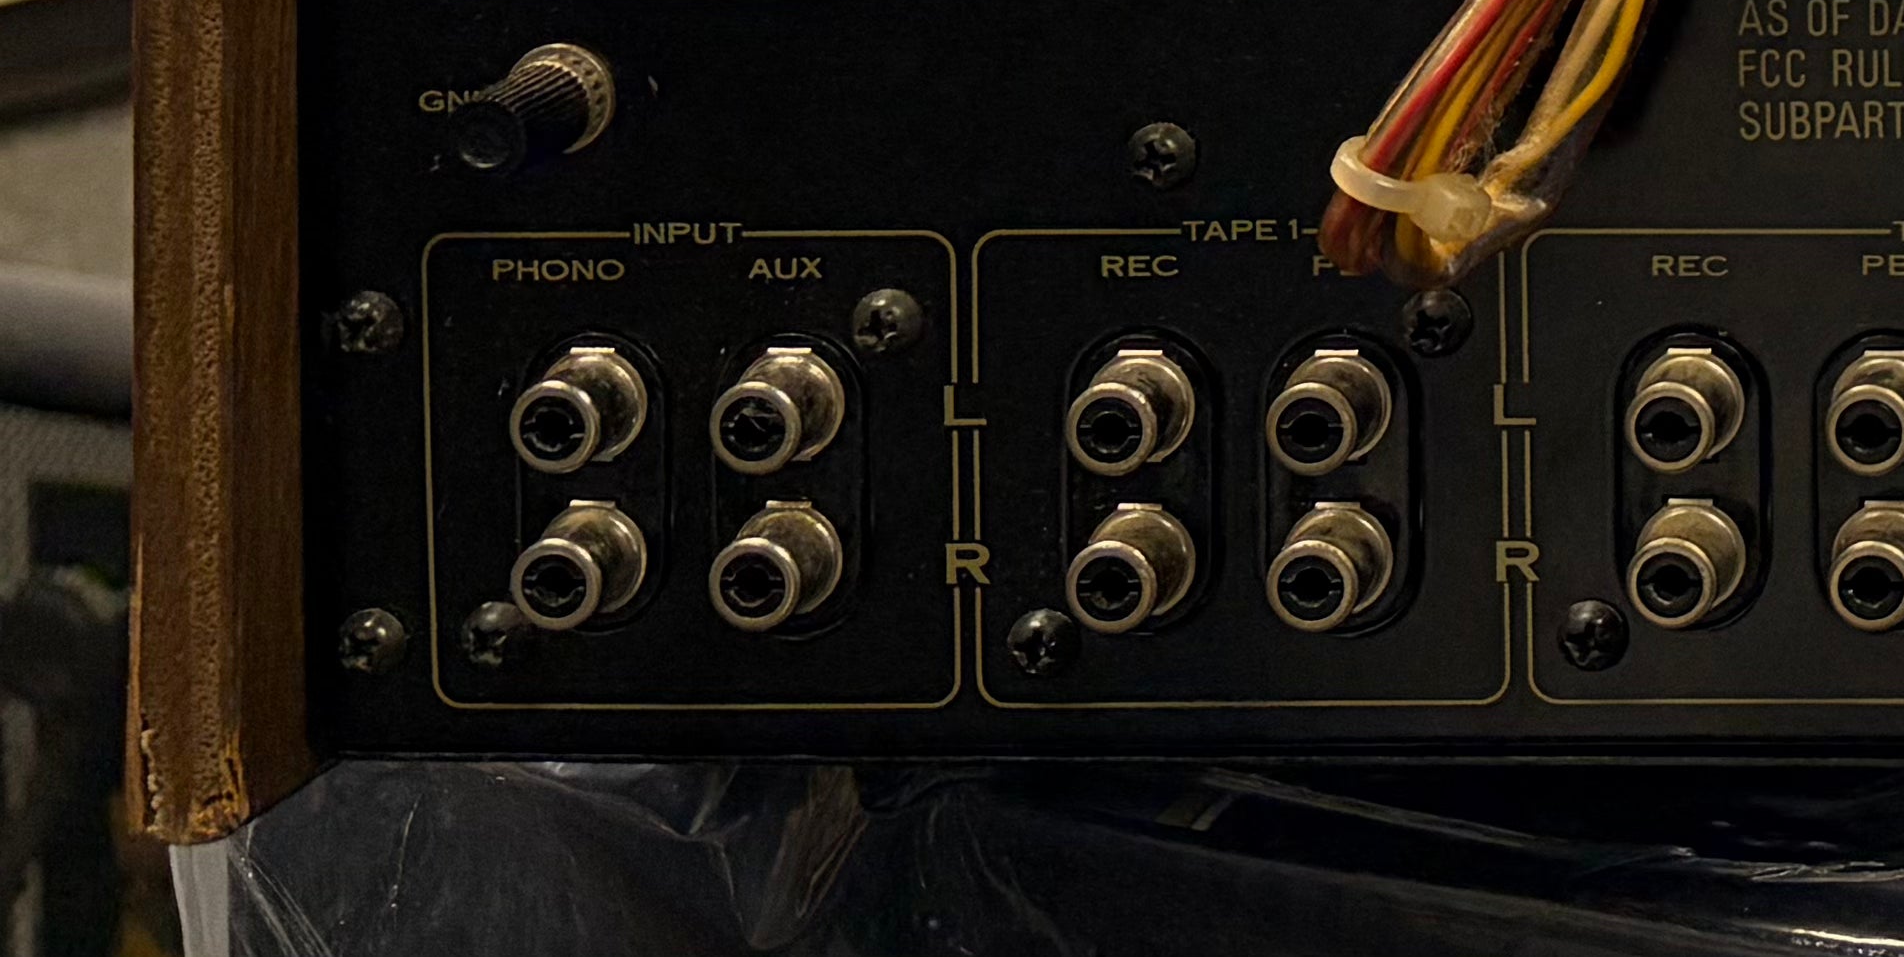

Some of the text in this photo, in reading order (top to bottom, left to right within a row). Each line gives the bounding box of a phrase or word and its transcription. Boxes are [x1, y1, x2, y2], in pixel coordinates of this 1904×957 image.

[1738, 48, 1806, 89] FCC
[418, 89, 480, 113] GN
[633, 221, 742, 245] INPUT
[1182, 218, 1299, 242] TAPE 1
[492, 258, 625, 282] PHONO
[748, 256, 823, 280] AUX
[1100, 254, 1179, 278] REC
[1651, 254, 1729, 277] REC
[943, 384, 988, 427] L
[1493, 382, 1537, 426] L
[944, 542, 991, 585] R
[1495, 540, 1540, 583] R
